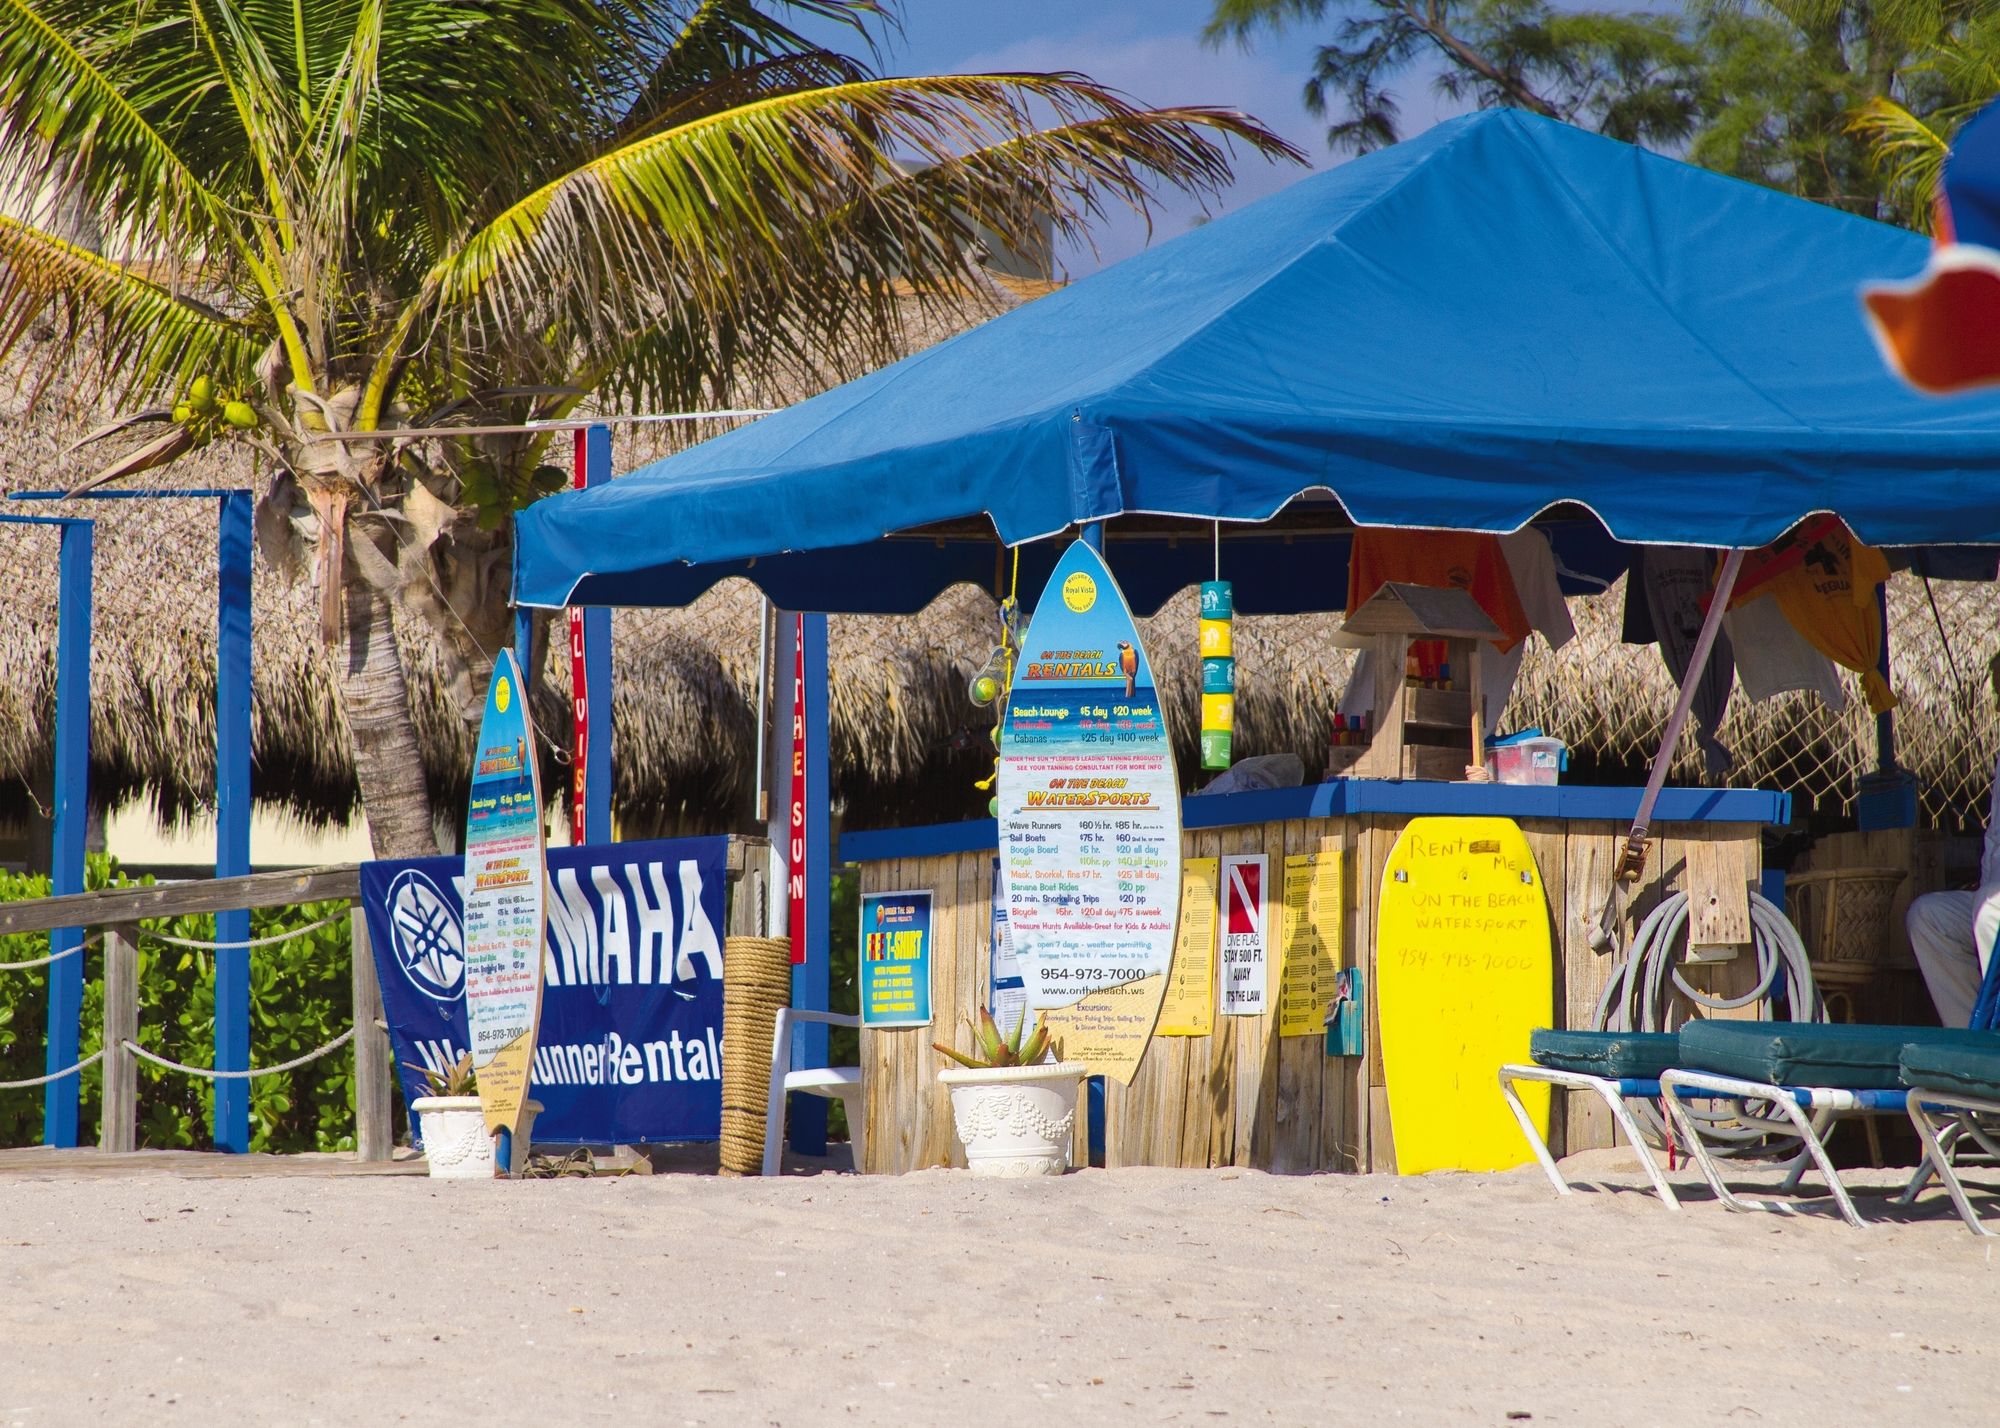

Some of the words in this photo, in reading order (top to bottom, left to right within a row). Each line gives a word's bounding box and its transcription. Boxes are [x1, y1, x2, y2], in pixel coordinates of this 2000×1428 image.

[1065, 586, 1080, 595] Royal
[1080, 586, 1095, 594] Vista
[1073, 650, 1103, 660] BEACH
[1027, 662, 1118, 677] RENTALS
[1013, 706, 1038, 718] Beach
[1040, 706, 1069, 720] Lounge
[1080, 706, 1091, 716] $5
[1092, 705, 1108, 719] day
[1113, 705, 1130, 716] $20
[1131, 705, 1153, 716] week
[1014, 733, 1047, 743] Cabanas
[1082, 733, 1097, 743] $25
[1100, 733, 1114, 745] day
[1117, 732, 1136, 742] $100
[1138, 732, 1160, 742] week
[1049, 778, 1066, 789] ON
[1067, 778, 1090, 789] THE
[1090, 778, 1128, 789] BEACH
[1009, 821, 1029, 830] Wave
[1031, 821, 1062, 830] Runners
[1102, 820, 1112, 830] hr.
[1115, 821, 1130, 830] $85
[1132, 820, 1142, 830] hr.
[1009, 833, 1022, 842] Sail
[1025, 833, 1046, 842] Boats
[1095, 833, 1104, 842] hr.
[792, 801, 804, 900] SUN
[1010, 845, 1035, 856] Boogie
[1037, 845, 1058, 854] Board
[1091, 845, 1100, 854] hr.
[1116, 845, 1131, 854] $20
[1133, 844, 1142, 853] all
[1144, 844, 1159, 856] day
[1010, 857, 1032, 868] Kayak
[1134, 857, 1142, 866] all
[1144, 857, 1158, 868] day
[1493, 856, 1516, 871] ME
[1092, 870, 1102, 879] hr.
[1134, 870, 1143, 878] all
[1145, 870, 1160, 881] day
[1011, 883, 1037, 891] Banana
[1039, 883, 1056, 891] Boat
[1058, 882, 1079, 891] Rides
[1118, 882, 1133, 891] $20
[1135, 885, 1145, 893] pp
[1011, 894, 1022, 903] 20
[1024, 894, 1040, 903] min.
[1043, 894, 1080, 905] Snorkeling
[1082, 894, 1100, 905] Trips
[1119, 894, 1134, 903] $20
[1136, 896, 1147, 905] pp
[1411, 892, 1441, 907] ON
[1449, 893, 1483, 907] THE
[1487, 893, 1536, 908] BEACH
[1012, 907, 1038, 918] Bicycle
[452, 859, 724, 987] MAHA
[1013, 922, 1040, 930] Treasure
[1042, 922, 1061, 930] Hunts
[1114, 922, 1123, 930] for
[1125, 922, 1139, 930] Kids
[1141, 922, 1147, 930] &
[1149, 922, 1171, 930] Adults!
[1037, 942, 1054, 950] open
[1062, 941, 1079, 950] days
[1116, 941, 1152, 950] permitting
[1242, 934, 1259, 946] FLAG
[1224, 949, 1238, 963] STAY
[1239, 949, 1252, 962] 500
[1253, 949, 1263, 962] FT.
[1041, 968, 1146, 980] 954-973-7000
[1233, 968, 1251, 981] AWAY
[1042, 985, 1145, 995] www.onthebeach.ws
[1235, 990, 1245, 1002] THE
[1247, 990, 1261, 1002] LAW
[1077, 1003, 1112, 1012] Excursion:
[478, 1027, 523, 1042] 954-973-7000
[608, 1027, 725, 1085] Rental
